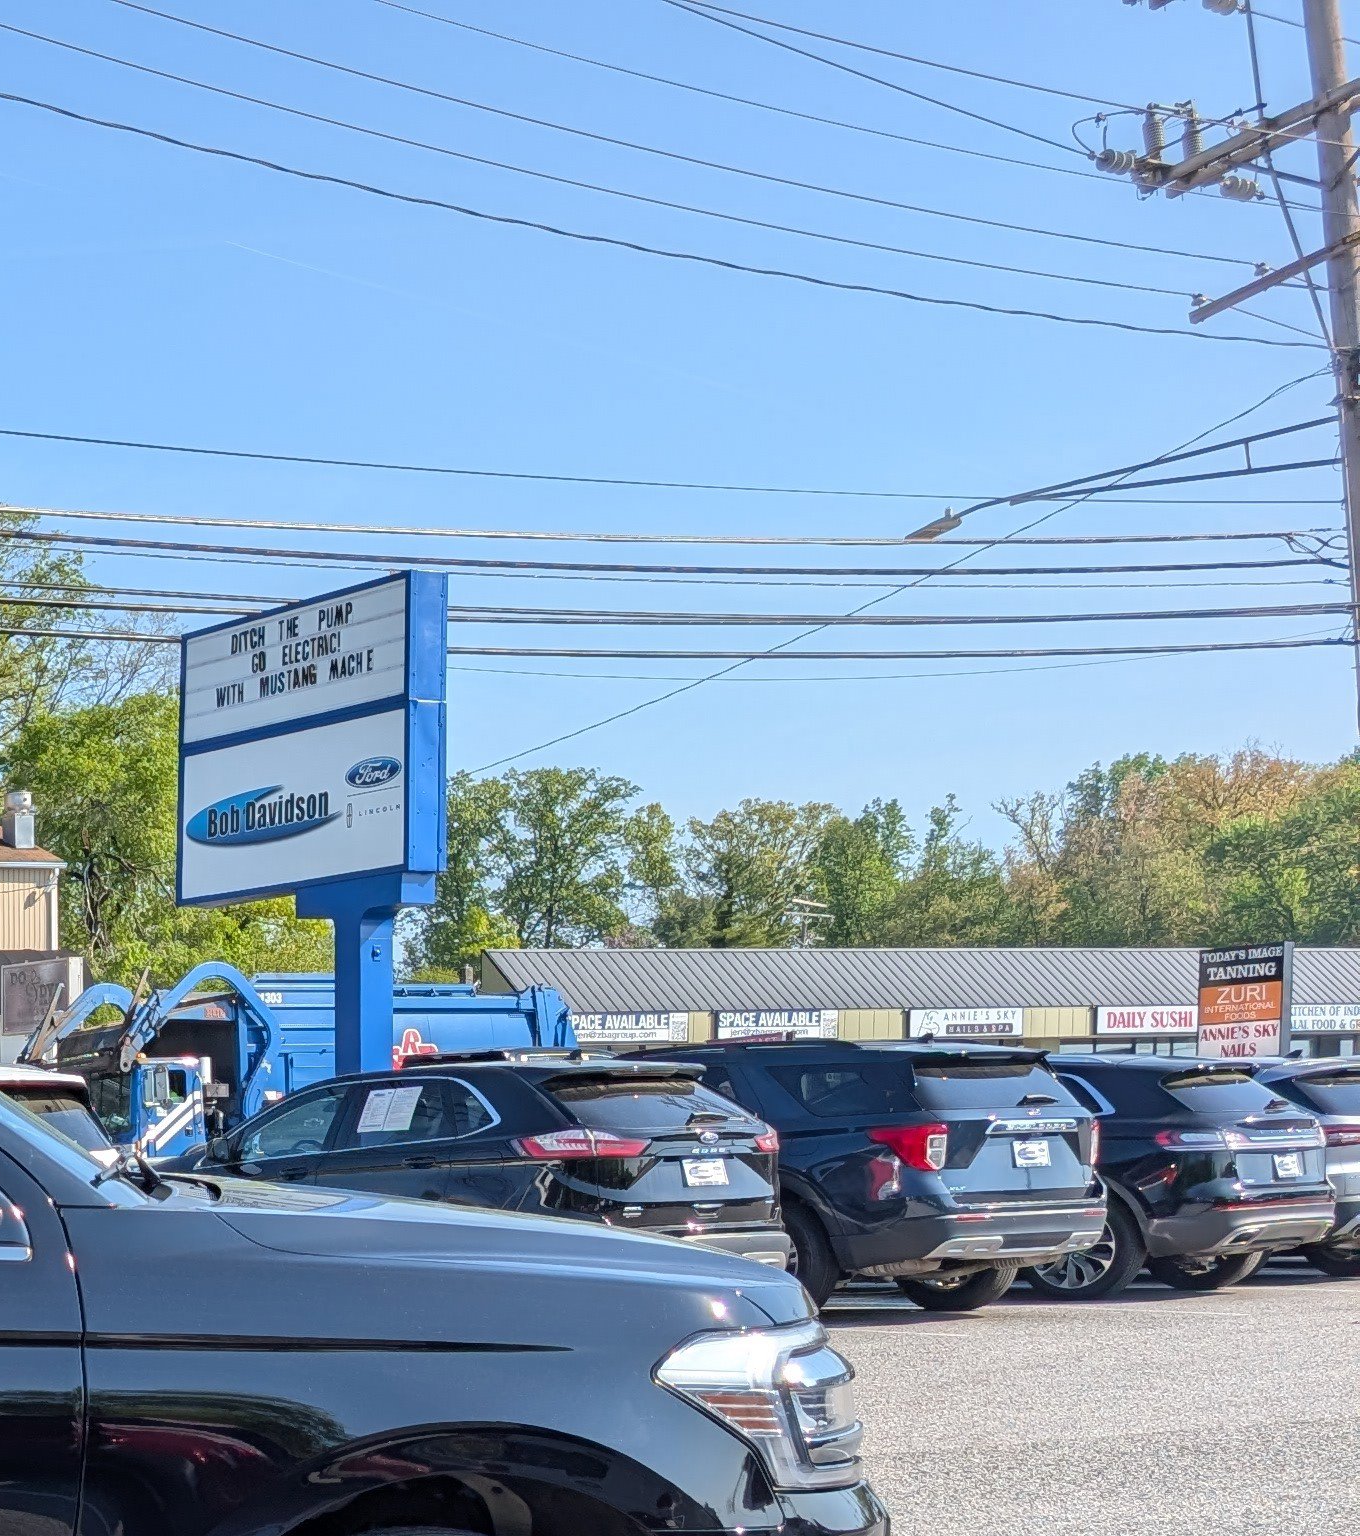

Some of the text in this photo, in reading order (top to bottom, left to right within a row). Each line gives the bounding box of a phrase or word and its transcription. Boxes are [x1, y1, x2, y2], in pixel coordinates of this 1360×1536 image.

[231, 602, 353, 655] DITCH THE PUMP
[252, 631, 341, 673] GO ELECTRIC!
[216, 683, 244, 708] WITH
[260, 664, 317, 698] MUSTANG
[354, 762, 391, 784] Ford
[207, 791, 329, 838] Bob Davidson
[358, 804, 401, 817] LINCOLN
[1202, 946, 1283, 964] TODAY'S IMAGE
[1207, 962, 1277, 981] TANNING
[1217, 984, 1266, 1004] ZURI
[943, 1010, 1016, 1021] ANNIE'S SKY
[1204, 1001, 1276, 1014] INTERNATIONAL
[1224, 1011, 1256, 1021] FOODS
[1329, 1006, 1341, 1016] OF
[1344, 1006, 1360, 1016] IND
[605, 1013, 669, 1029] AVAILABLE
[719, 1011, 819, 1027] SPACE AVAILABLE
[1106, 1011, 1193, 1028] DAILY SUSHI
[1312, 1019, 1336, 1029] FOOD
[1339, 1019, 1347, 1029] &
[1200, 1023, 1278, 1042] ANNIE'S SKY
[1220, 1042, 1257, 1058] NAILS
